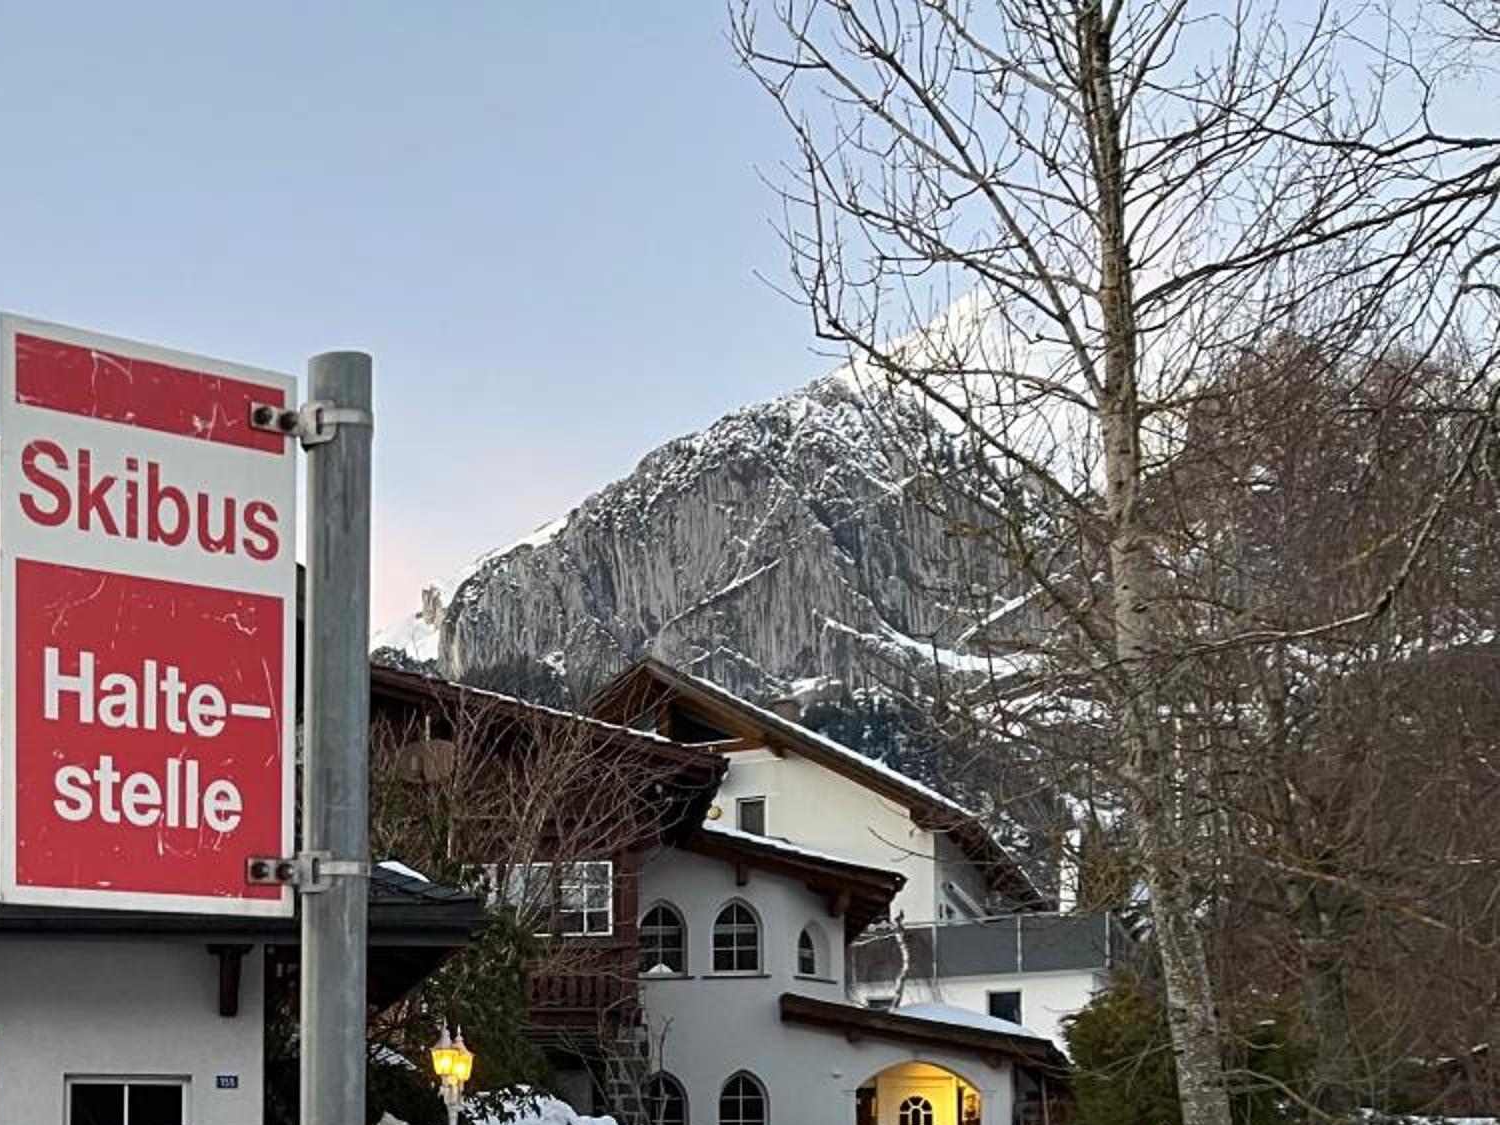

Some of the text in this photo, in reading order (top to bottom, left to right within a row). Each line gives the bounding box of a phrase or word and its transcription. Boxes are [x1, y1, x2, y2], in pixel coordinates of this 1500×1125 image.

[19, 439, 279, 561] Skibus
[43, 646, 271, 737] Halte-
[53, 755, 243, 833] stelle
